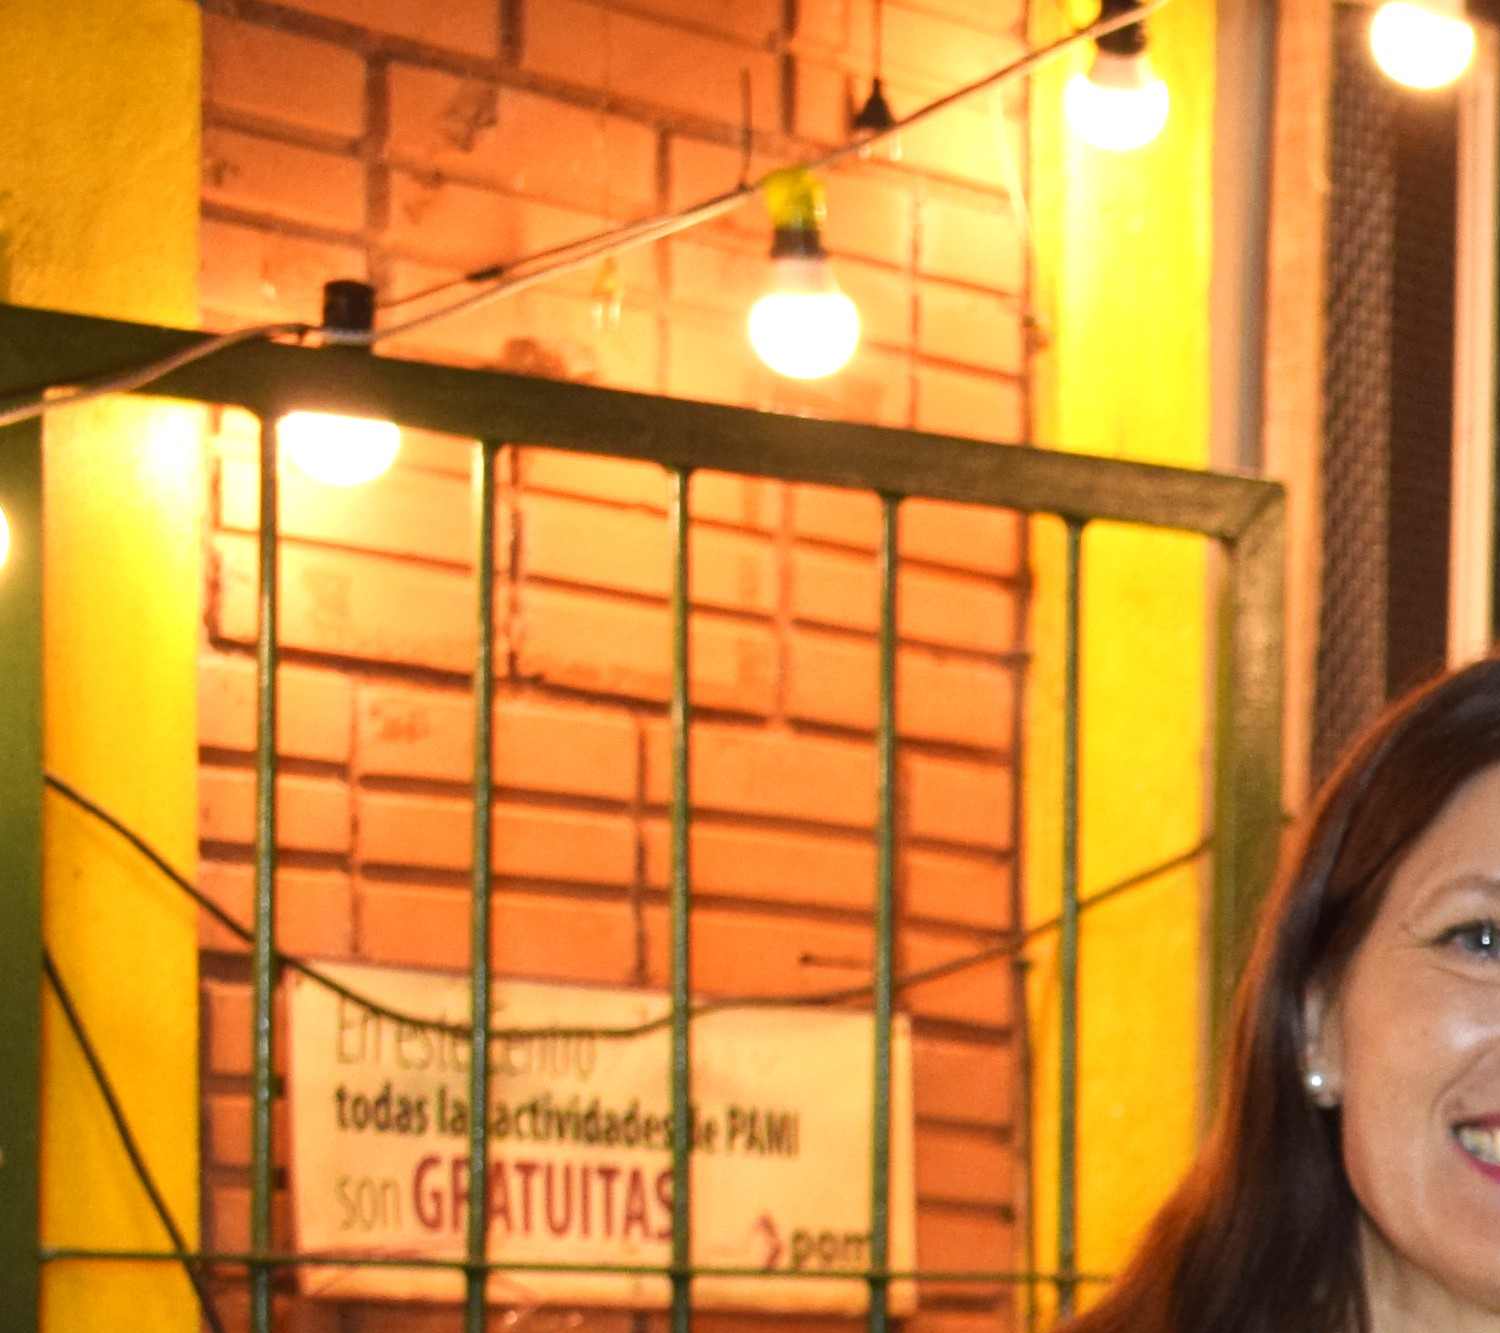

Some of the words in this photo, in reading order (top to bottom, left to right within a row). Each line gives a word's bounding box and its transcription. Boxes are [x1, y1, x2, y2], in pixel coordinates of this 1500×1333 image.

[334, 1083, 429, 1135] todas
[438, 1085, 472, 1135] la
[335, 1175, 401, 1231] son
[412, 1154, 675, 1241] GRATUITAS
